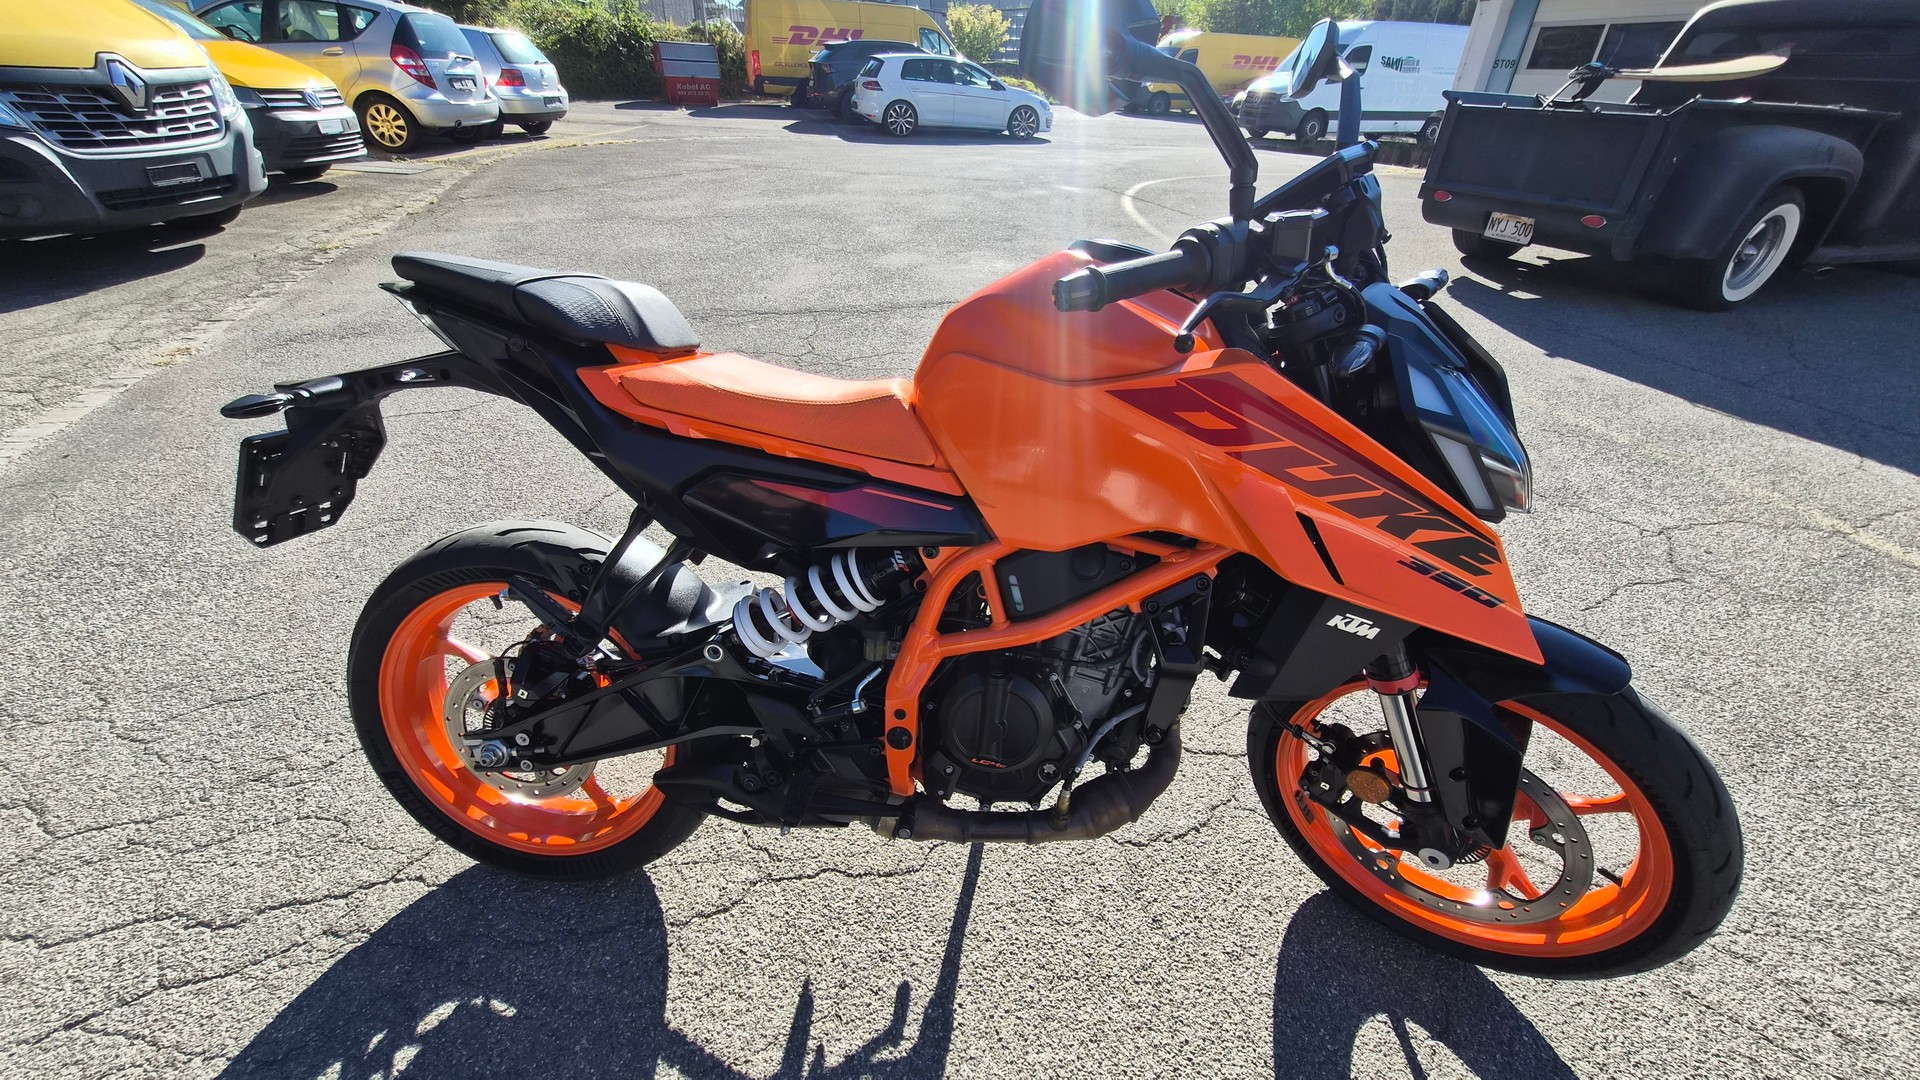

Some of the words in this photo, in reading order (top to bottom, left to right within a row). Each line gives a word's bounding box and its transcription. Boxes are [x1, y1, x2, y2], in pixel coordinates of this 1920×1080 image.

[1231, 55, 1280, 71] DHL
[1380, 55, 1404, 73] SALVI
[1493, 60, 1516, 69] ST09
[1487, 217, 1510, 233] NYJ
[1511, 220, 1533, 237] 500
[1105, 371, 1502, 577] DUKE
[1325, 613, 1381, 640] KTM
